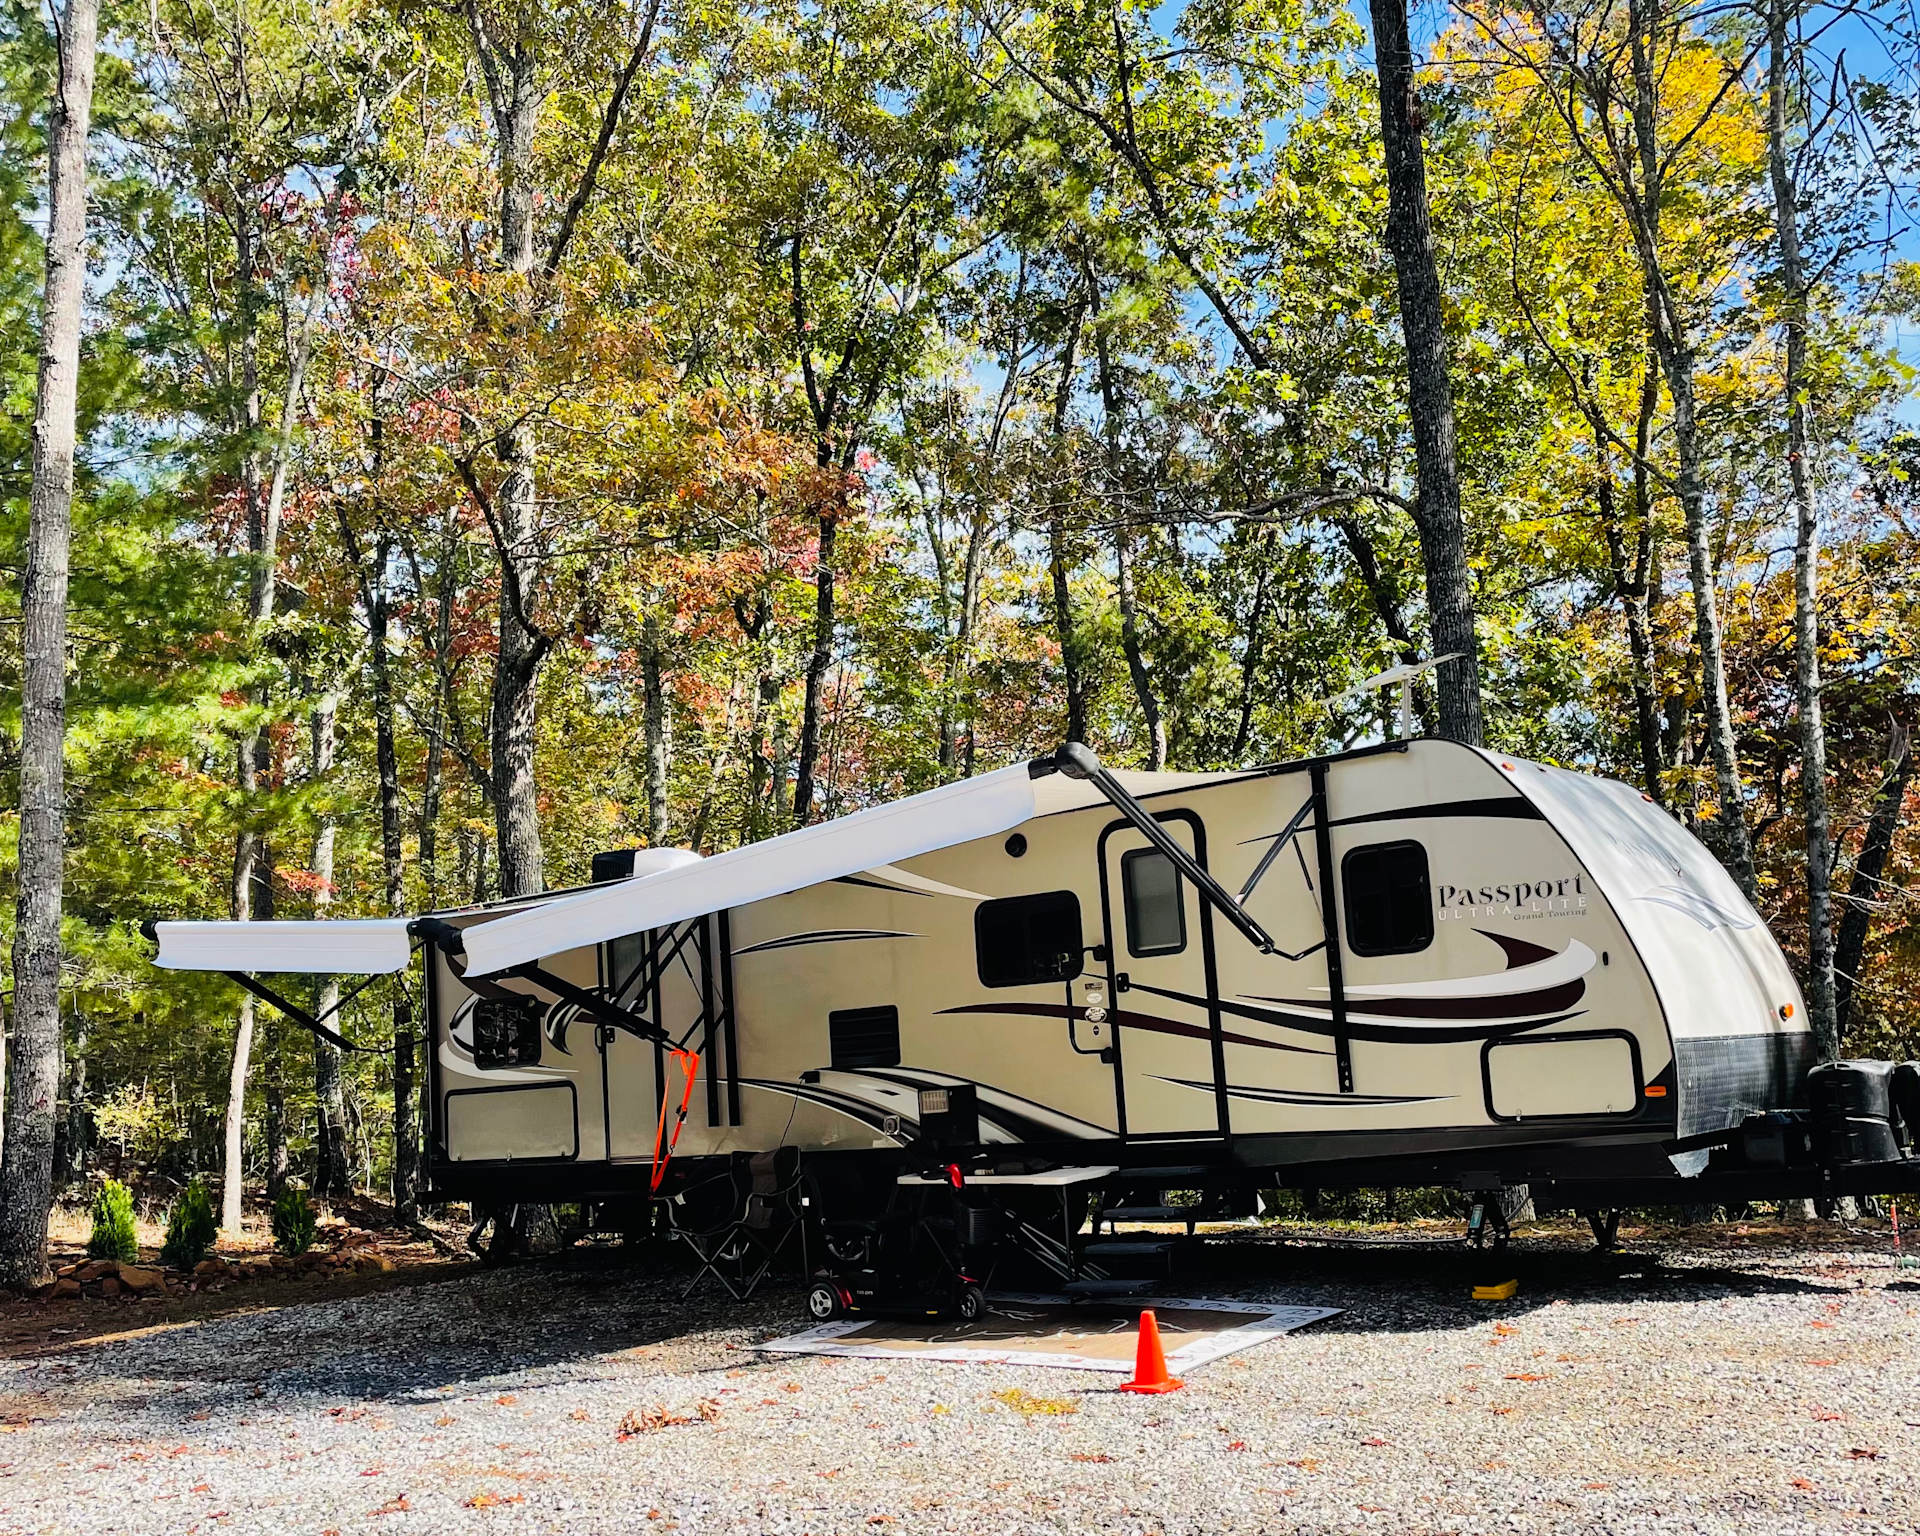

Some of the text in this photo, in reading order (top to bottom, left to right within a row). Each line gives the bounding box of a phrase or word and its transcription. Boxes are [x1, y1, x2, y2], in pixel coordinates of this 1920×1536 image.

[1436, 873, 1587, 908] Passport
[1438, 896, 1587, 921] ULTRA LITE
[1513, 909, 1587, 921] Grand Touring
